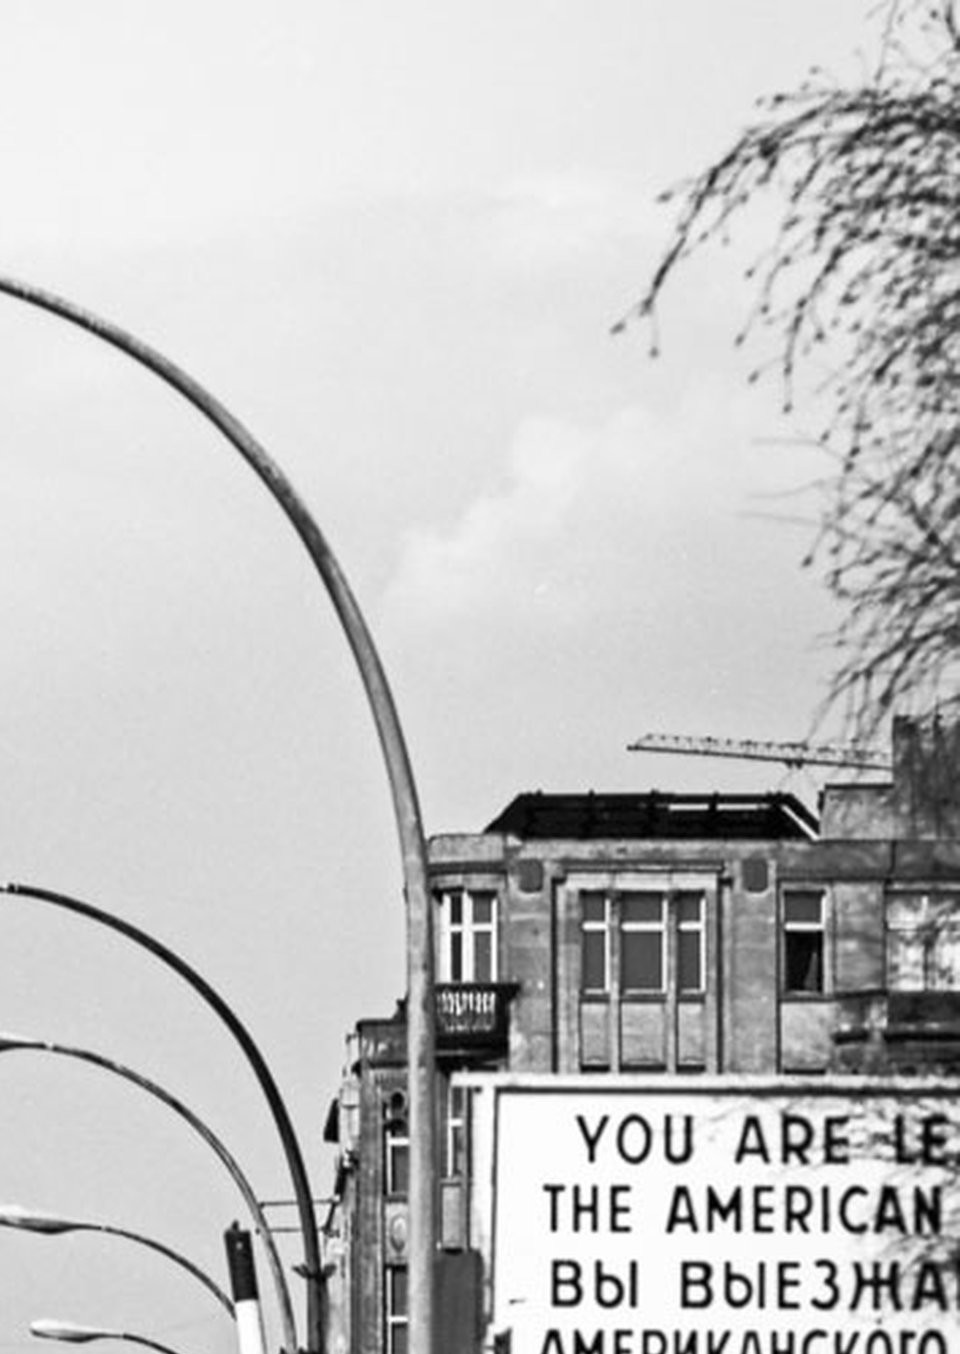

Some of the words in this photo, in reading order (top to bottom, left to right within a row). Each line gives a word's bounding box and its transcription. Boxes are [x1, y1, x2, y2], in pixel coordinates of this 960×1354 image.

[576, 1114, 694, 1165] YOU
[735, 1114, 849, 1166] ARE
[543, 1184, 632, 1233] THE
[667, 1184, 943, 1235] AMERICAN
[551, 1260, 638, 1308] ВЫ
[681, 1259, 960, 1311] ВЫЕЗЖА
